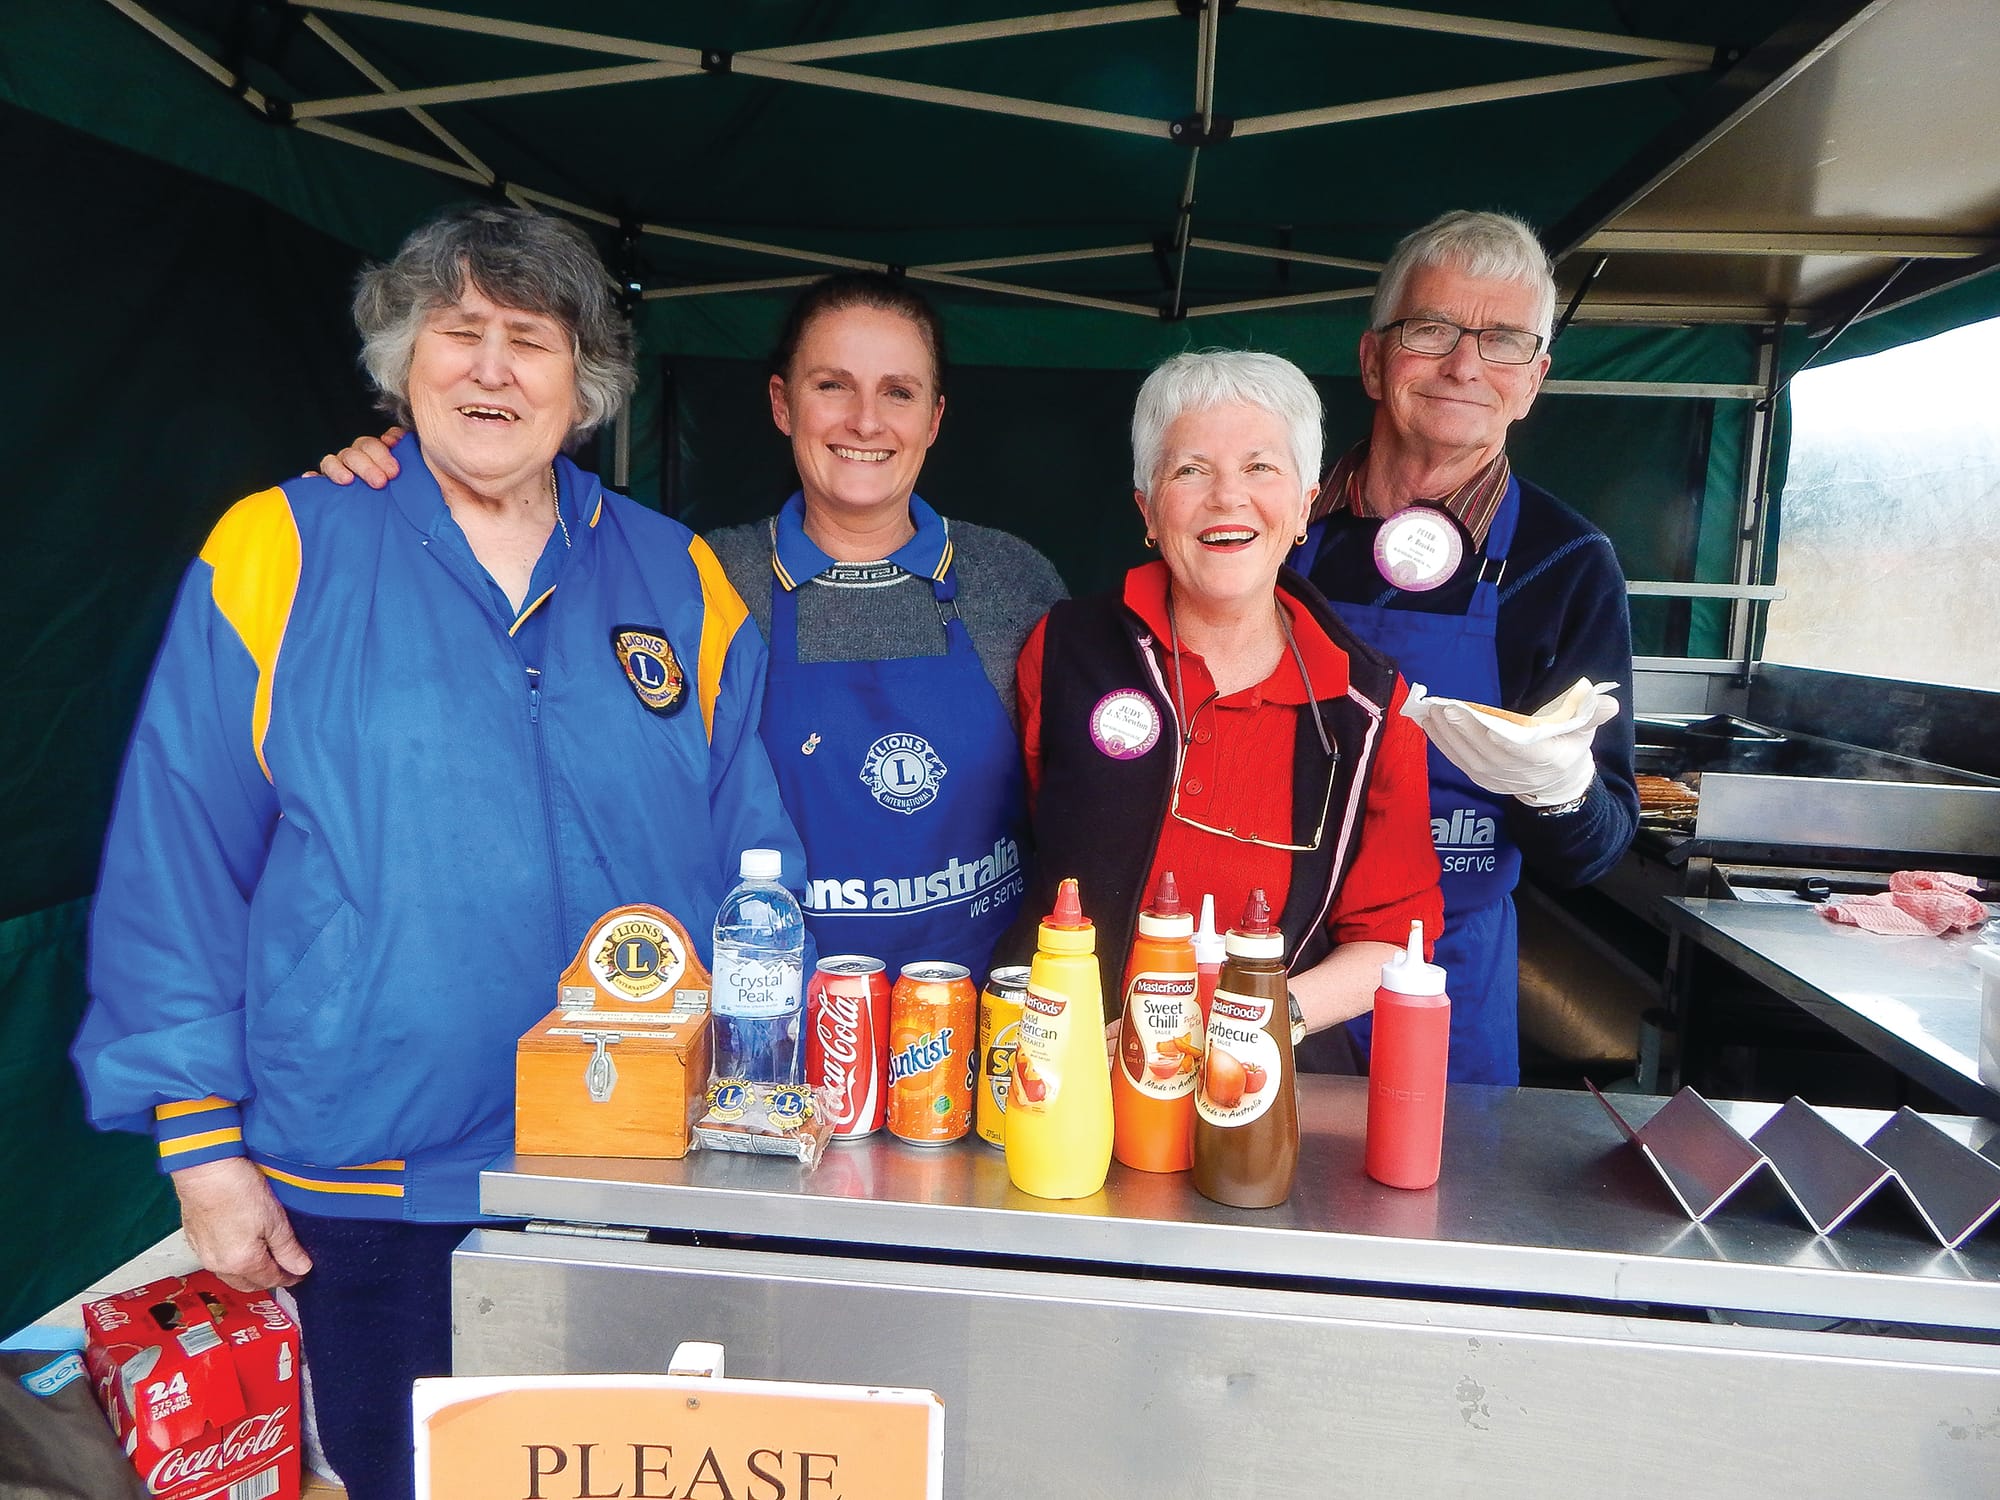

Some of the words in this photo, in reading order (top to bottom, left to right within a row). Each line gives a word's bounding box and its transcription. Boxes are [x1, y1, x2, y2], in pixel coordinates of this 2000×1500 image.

[623, 635, 662, 653] LIONS
[636, 654, 660, 686] L
[1119, 705, 1143, 719] JUDY
[875, 736, 924, 755] LIONS
[893, 759, 917, 786] L
[882, 791, 932, 807] INTERNATIONAL
[871, 836, 1020, 910] australia
[1442, 855, 1497, 873] serve
[970, 896, 990, 919] we
[994, 875, 1024, 908] serve
[617, 923, 660, 938] LIONS
[626, 942, 650, 973] L
[615, 978, 660, 991] INTERNATIONAL
[729, 972, 783, 990] Crystal
[1137, 981, 1194, 994] MasterFoods
[738, 989, 774, 1003] Peak
[1143, 999, 1183, 1015] Sweet
[1148, 1015, 1179, 1029] Chilli
[1208, 1019, 1259, 1044] arbecue
[1144, 1079, 1167, 1091] Made
[1200, 1100, 1218, 1117] Made
[1228, 1099, 1262, 1119] Australia
[147, 1370, 189, 1404] 24
[151, 1398, 173, 1414] 375
[153, 1407, 171, 1421] CAN
[170, 1400, 193, 1413] PACK
[147, 1403, 292, 1495] Coca-Cola
[521, 1443, 843, 1500] PLEASE
